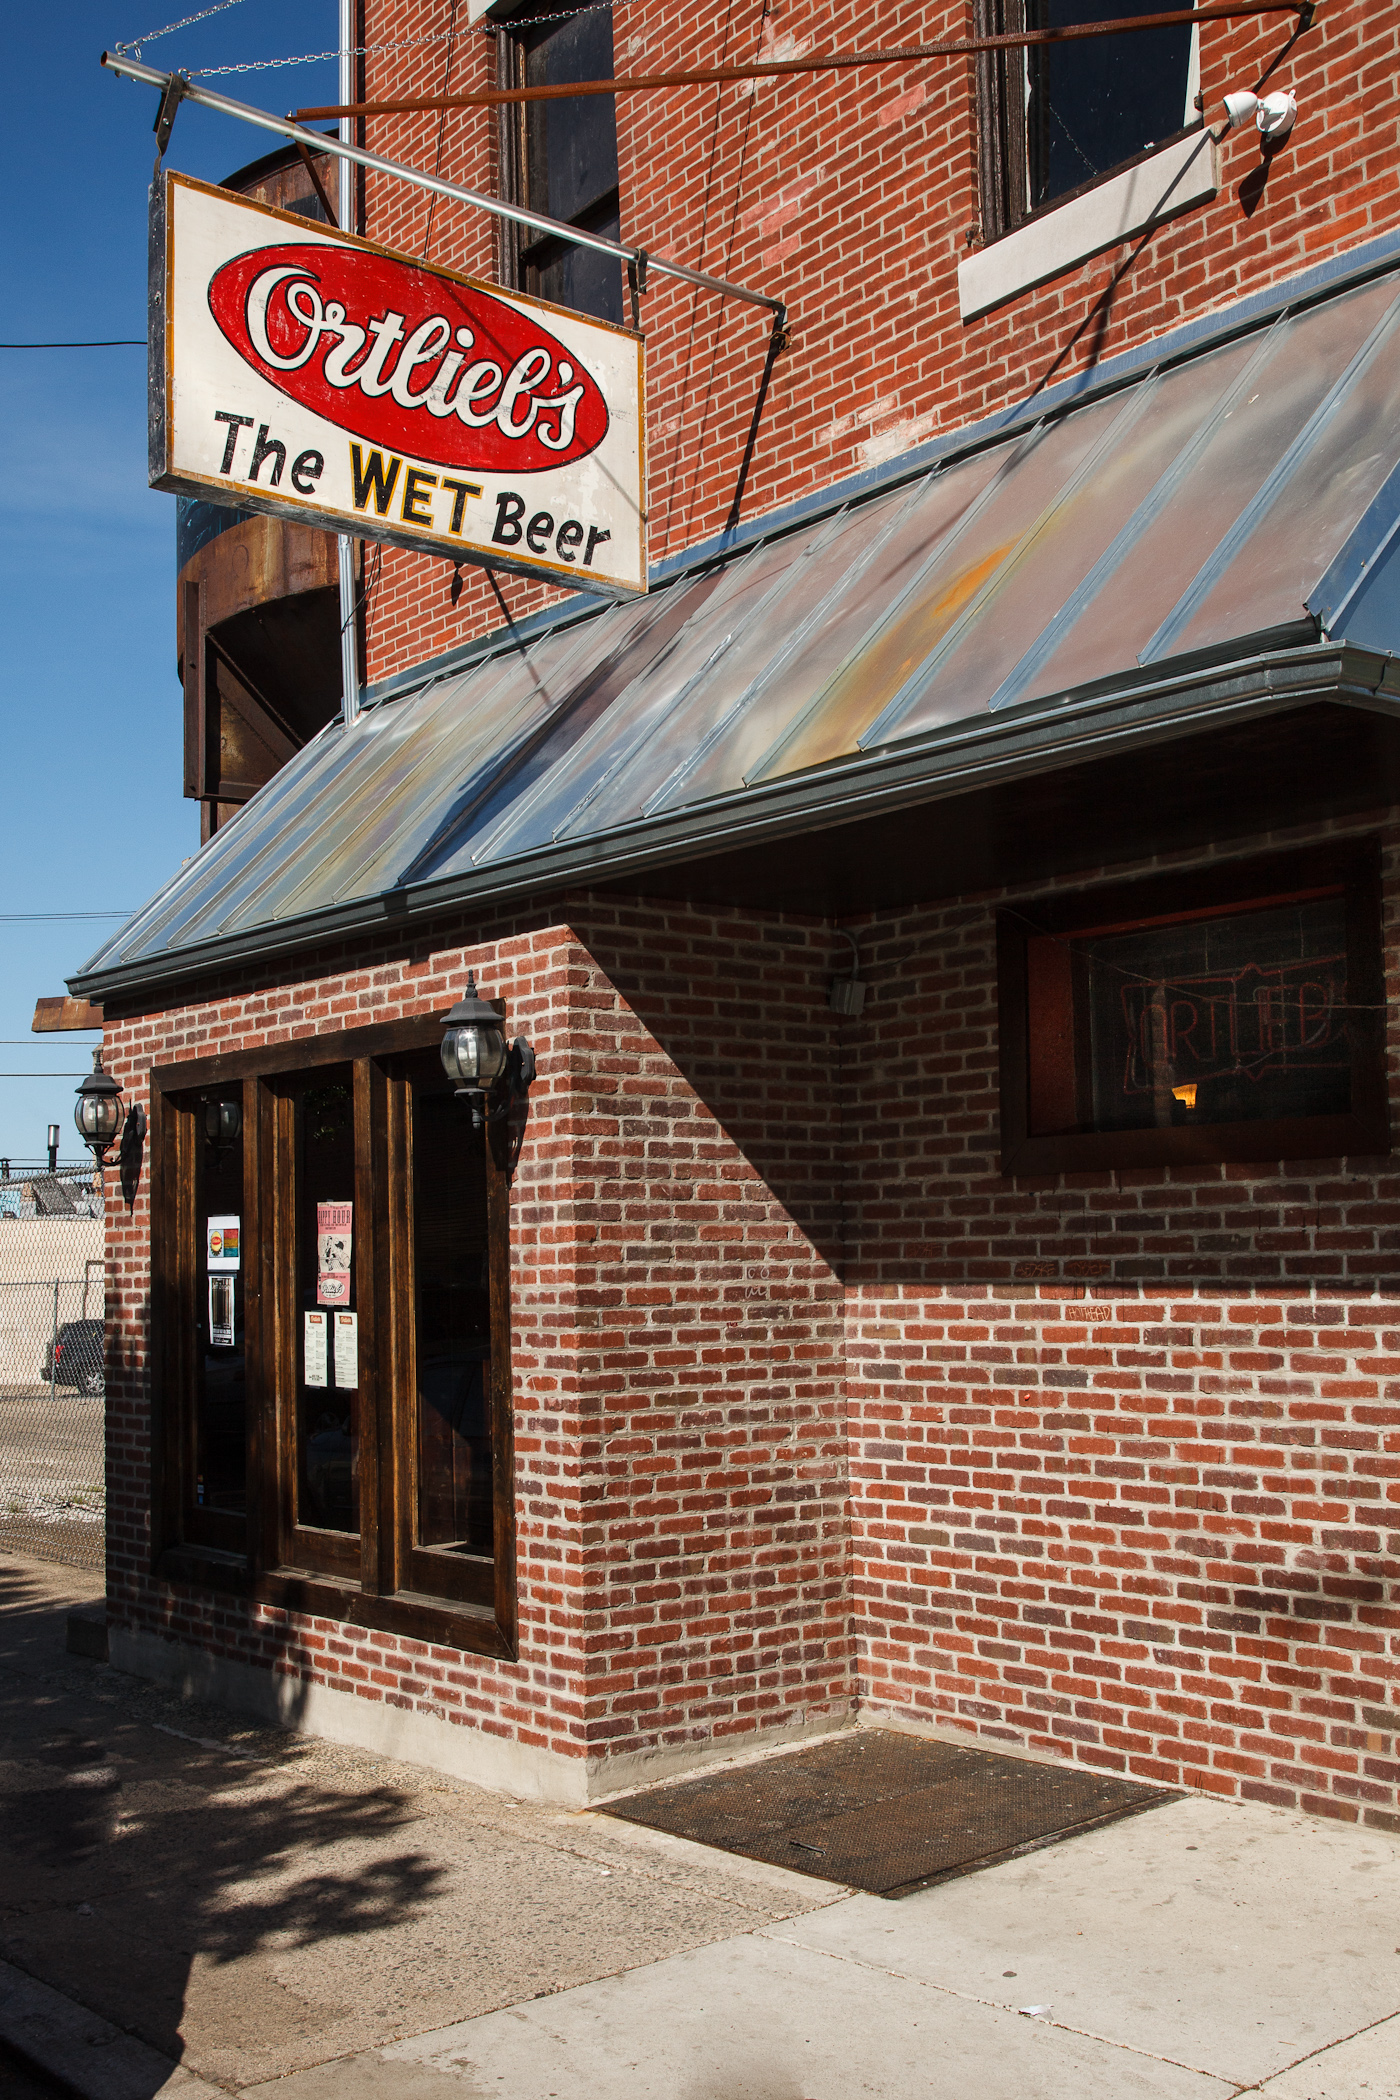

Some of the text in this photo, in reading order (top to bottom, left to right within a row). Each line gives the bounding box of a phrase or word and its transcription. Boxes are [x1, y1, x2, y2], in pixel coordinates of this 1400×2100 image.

[246, 264, 583, 450] Ortlieb's
[214, 410, 611, 566] The WET Beer
[333, 1210, 351, 1224] HOUR
